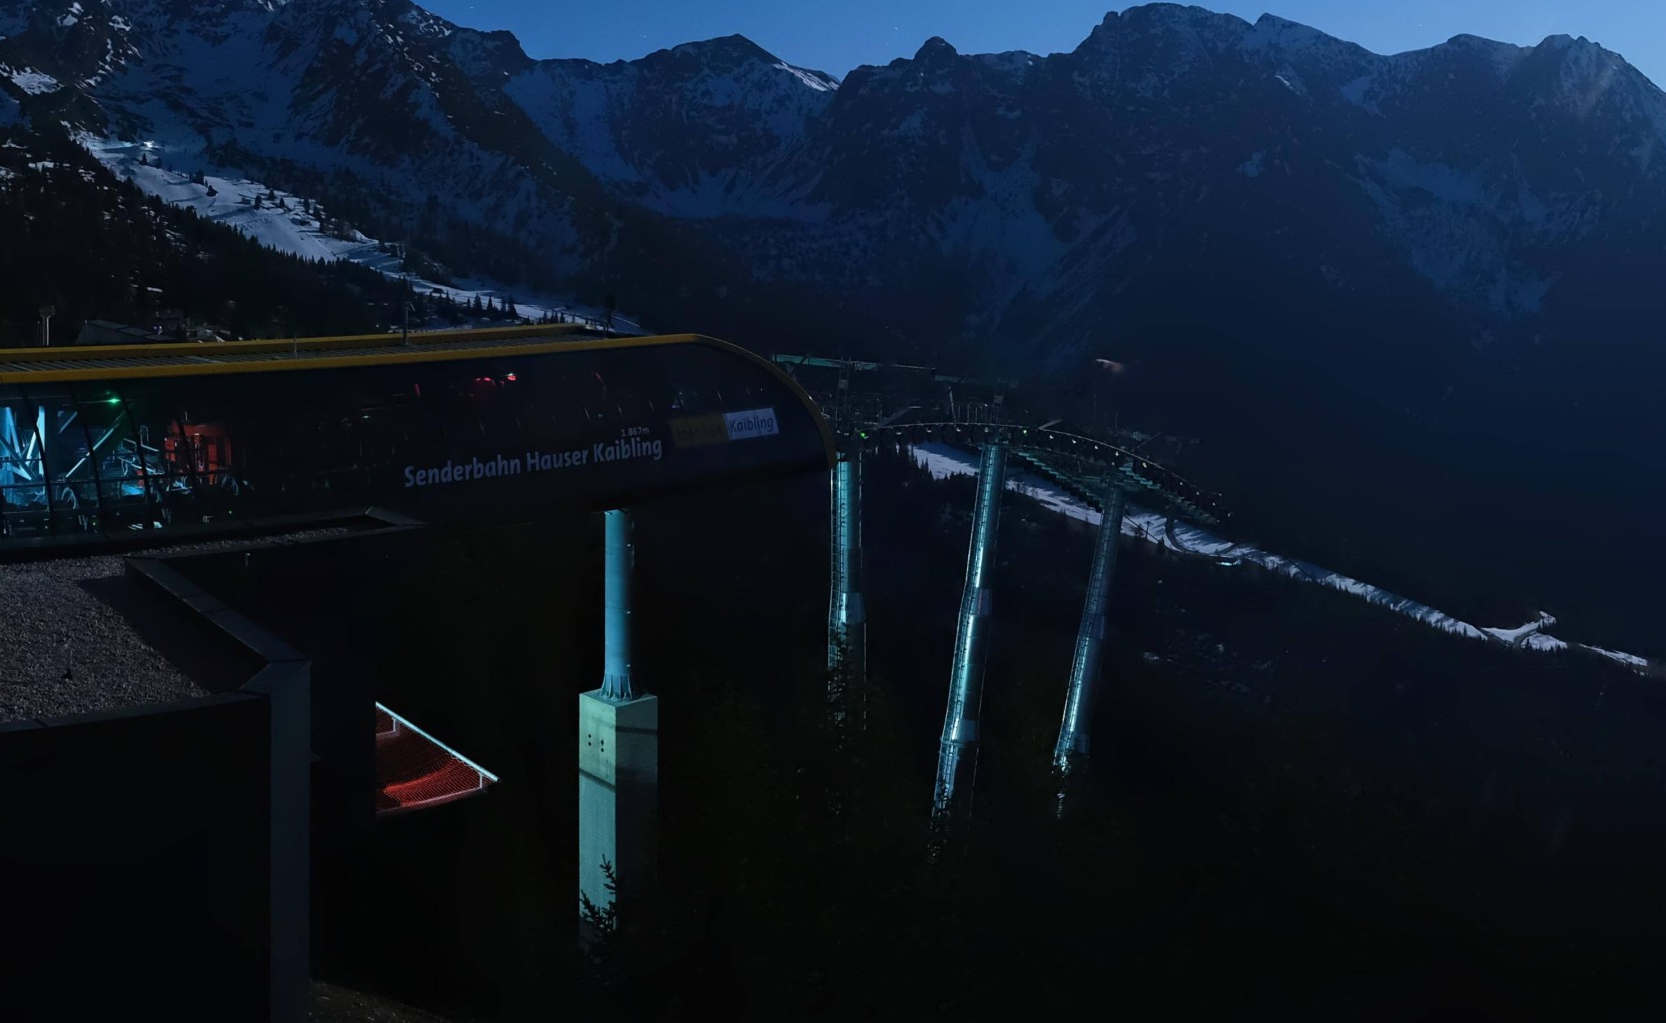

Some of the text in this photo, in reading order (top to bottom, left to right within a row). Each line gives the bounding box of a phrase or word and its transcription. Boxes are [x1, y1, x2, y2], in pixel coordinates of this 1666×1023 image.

[730, 416, 774, 433] Kaibling
[404, 436, 663, 488] Senderbahn Hauser Kaibling
